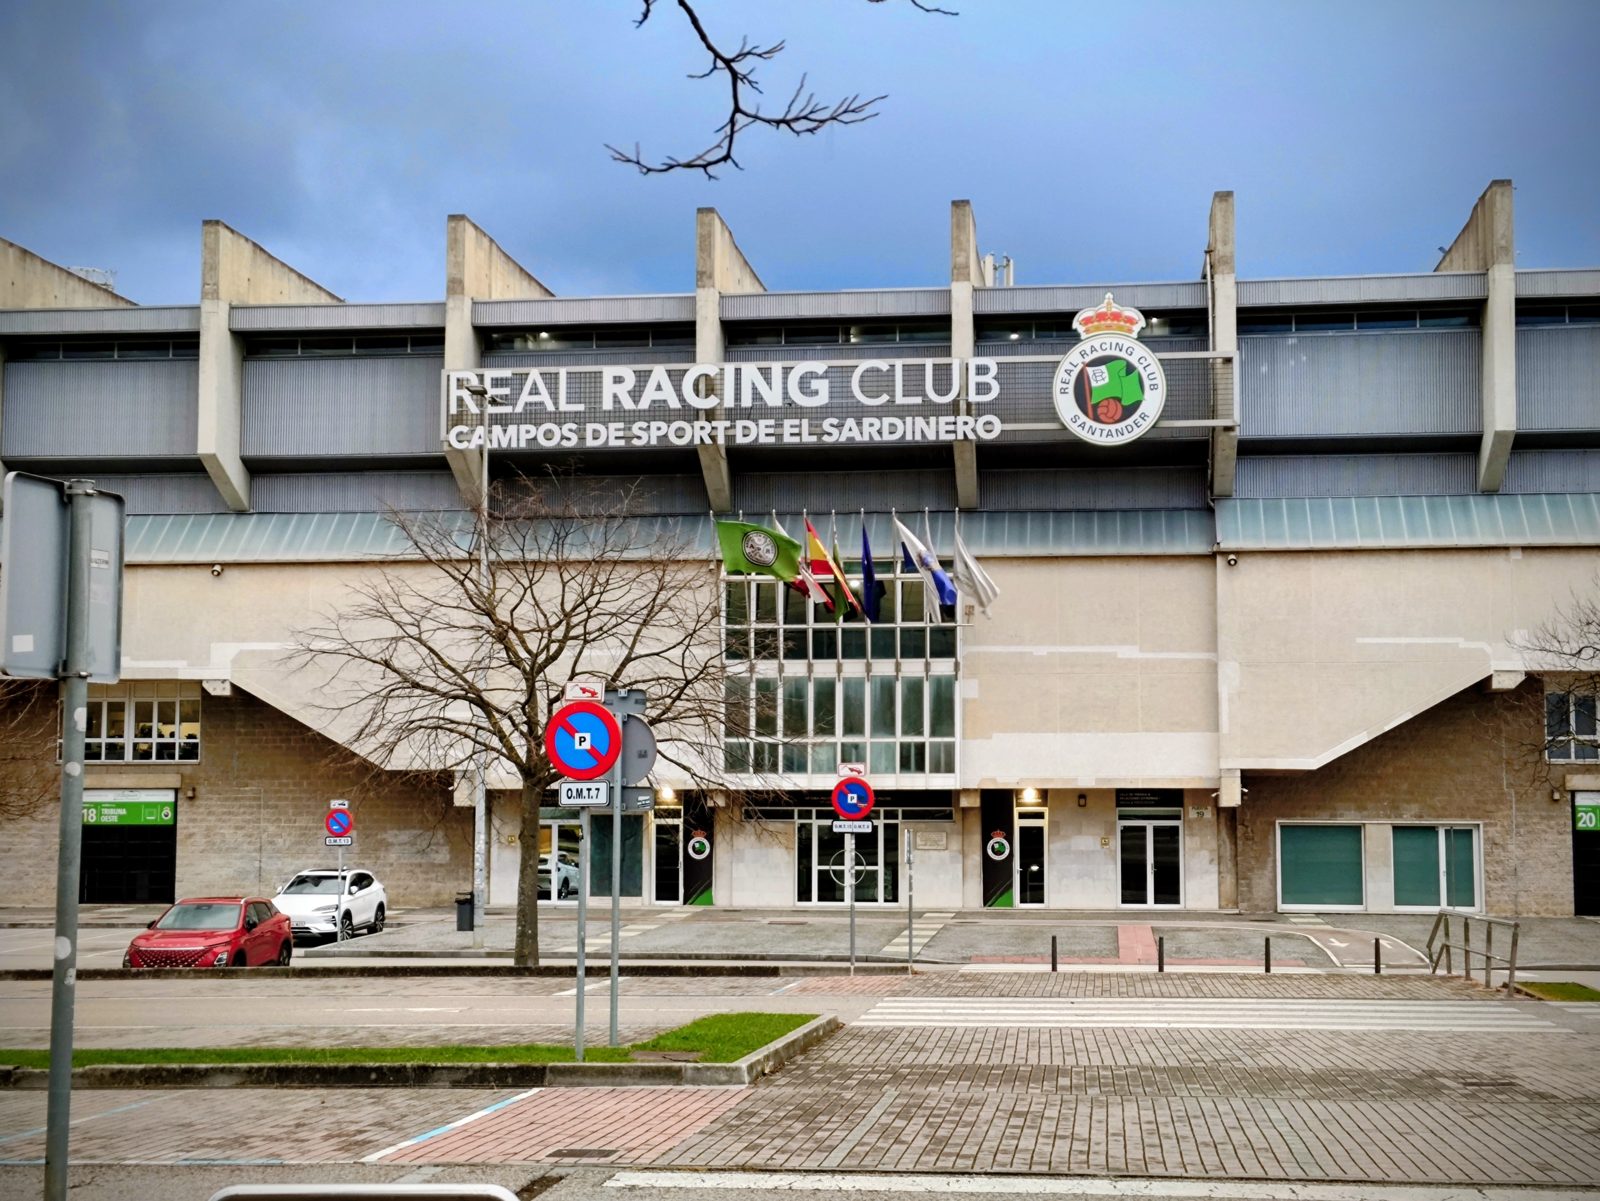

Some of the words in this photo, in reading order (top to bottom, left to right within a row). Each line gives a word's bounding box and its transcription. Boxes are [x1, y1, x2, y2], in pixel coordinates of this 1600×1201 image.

[1060, 361, 1079, 394] REAL
[1079, 342, 1135, 359] RACING
[1137, 356, 1159, 391] CLUB
[449, 368, 585, 414] REAL
[602, 361, 830, 410] RACING
[851, 358, 1000, 405] CLUB
[448, 422, 579, 449] CAMPOS
[586, 422, 625, 446] DE
[631, 420, 731, 446] SPORT
[735, 419, 775, 444] DE
[783, 418, 817, 443] EL
[821, 414, 1002, 441] SARDINERO
[1070, 411, 1150, 438] SANTANDER
[578, 736, 587, 747] P
[81, 808, 97, 822] 18
[1577, 812, 1596, 828] 20
